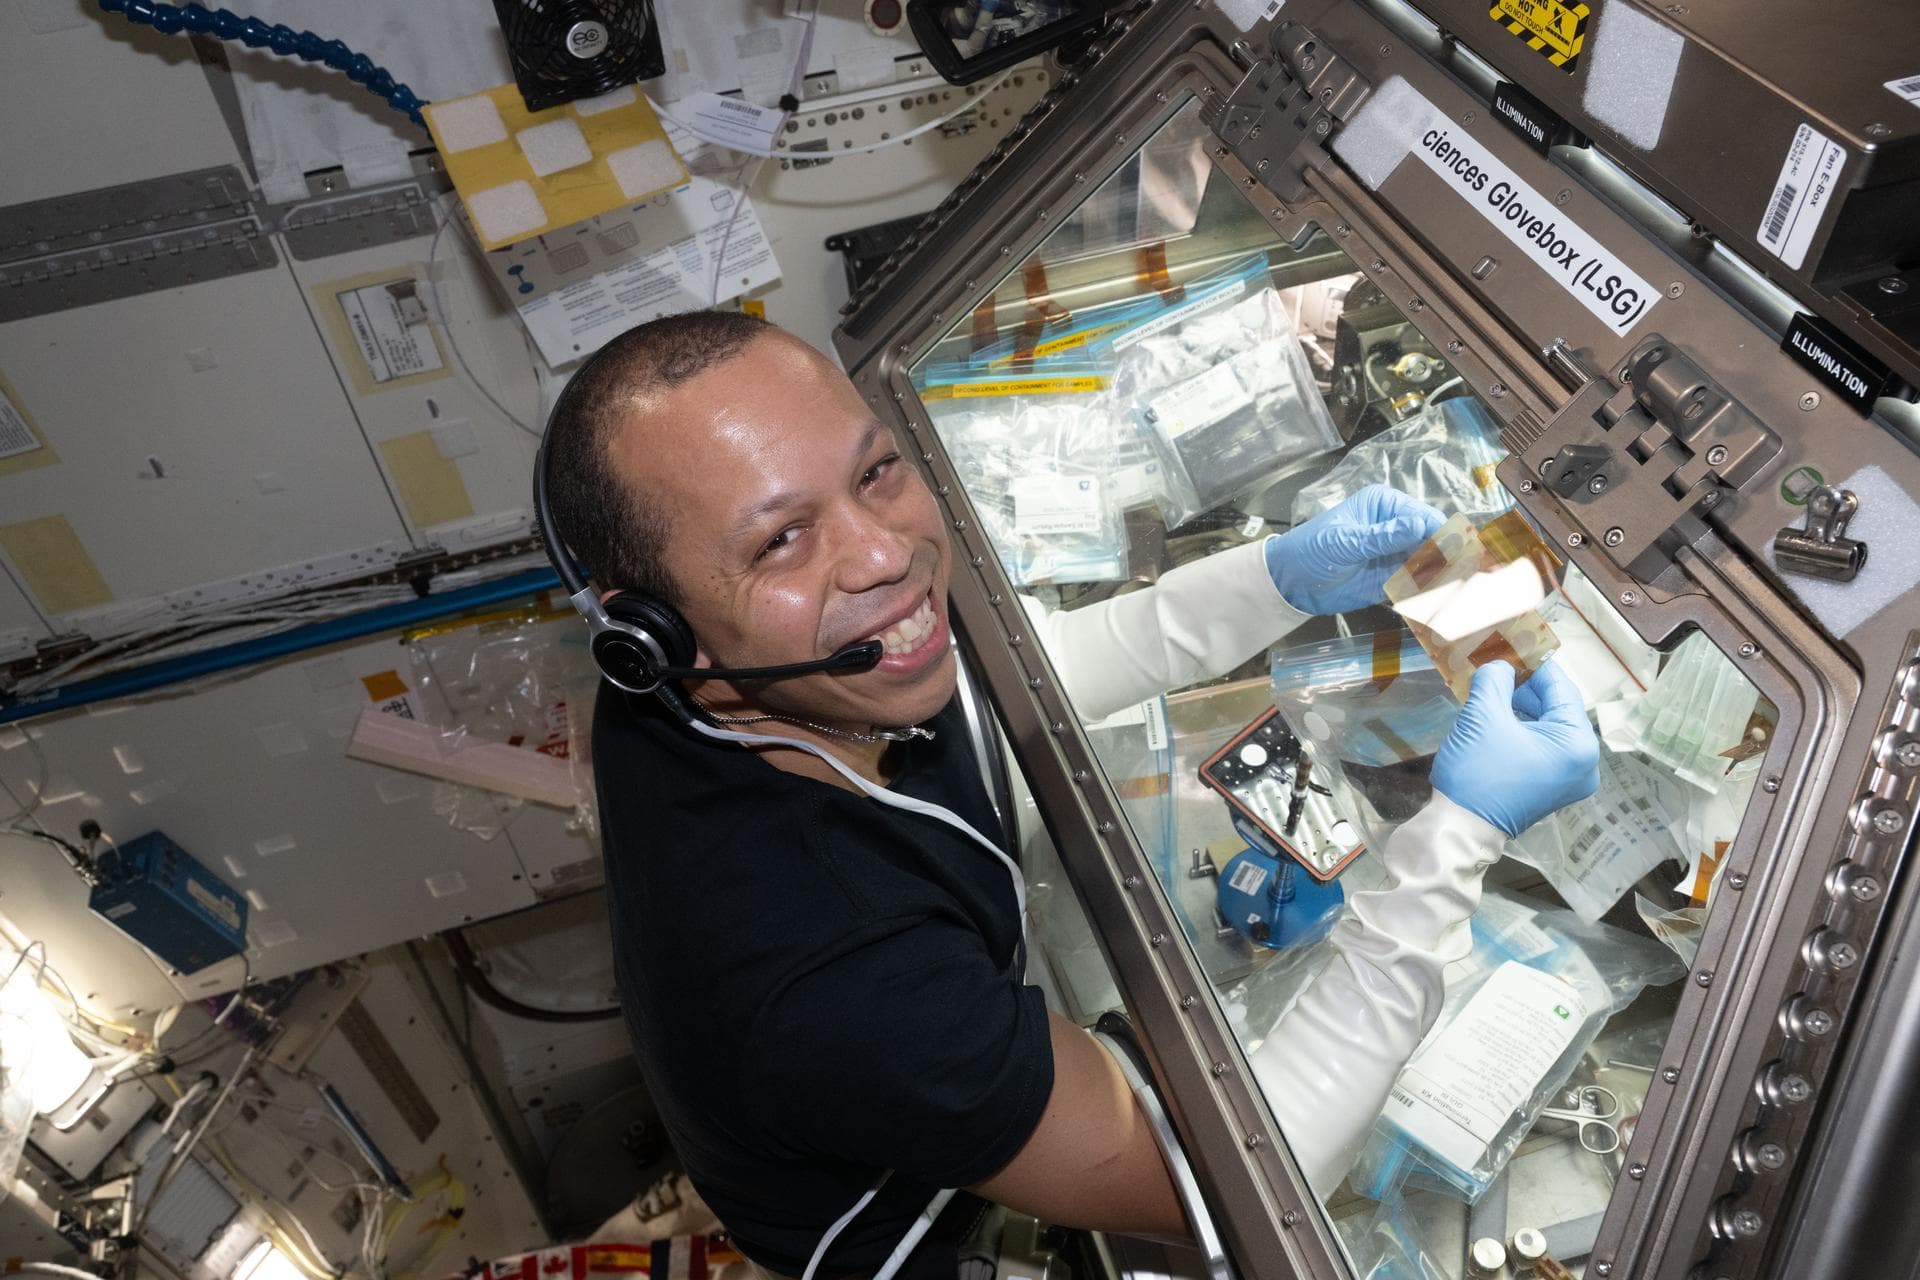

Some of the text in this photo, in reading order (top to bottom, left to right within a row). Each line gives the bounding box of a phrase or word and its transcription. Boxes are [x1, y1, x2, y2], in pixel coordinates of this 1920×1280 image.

[1505, 2, 1544, 34] DO NOT TOUCH
[1518, 0, 1535, 16] HOT
[1496, 96, 1544, 142] ILLUMINATION
[1810, 147, 1840, 207] Fan E-Box
[1422, 129, 1646, 328] ciences Glovebox (LSG)
[1791, 331, 1868, 398] ILLUMINATION
